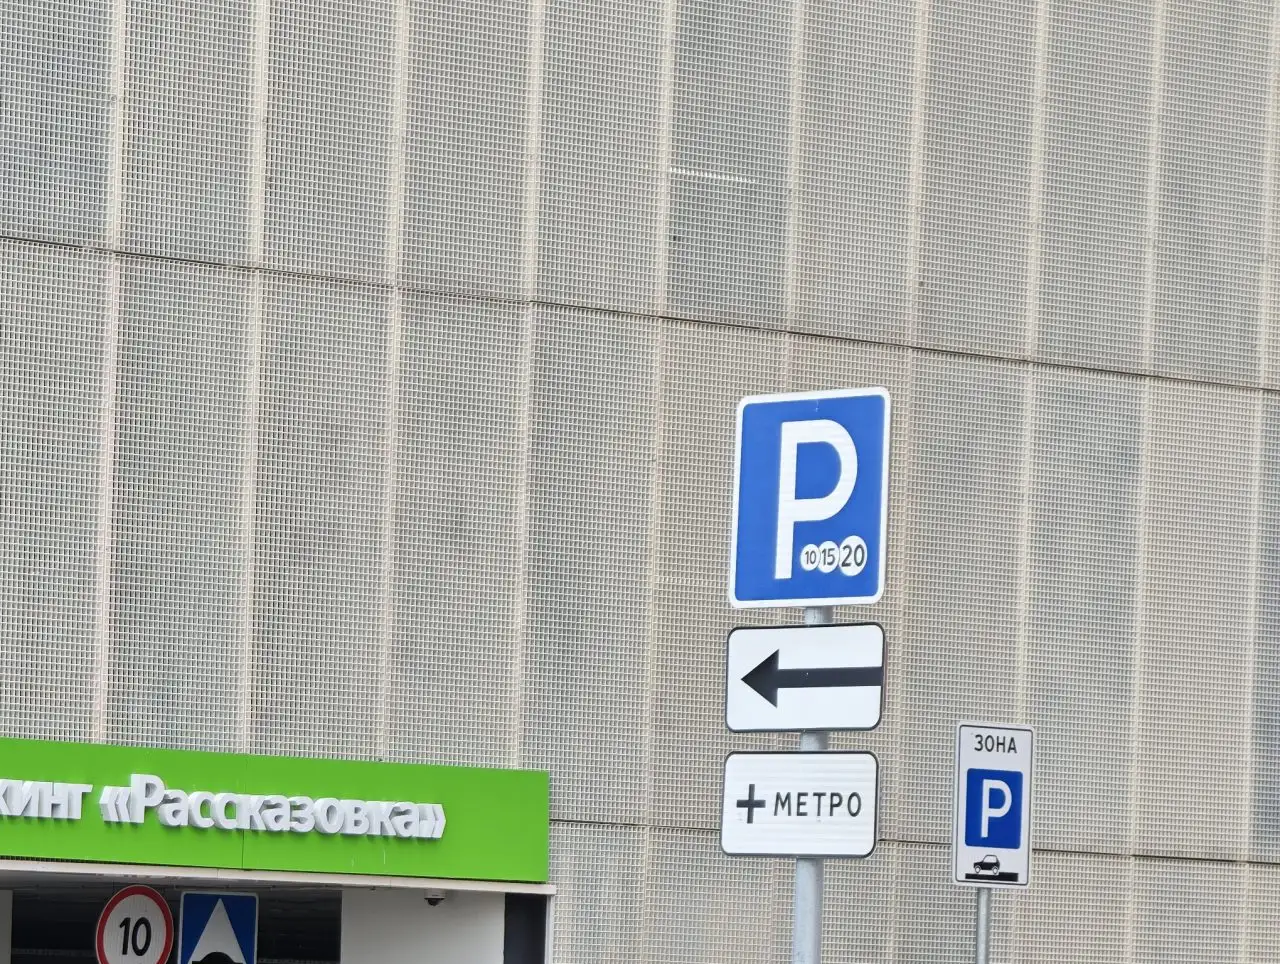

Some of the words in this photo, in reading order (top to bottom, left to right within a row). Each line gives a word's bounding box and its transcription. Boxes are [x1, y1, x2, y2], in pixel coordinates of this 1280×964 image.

[774, 418, 858, 580] P
[804, 550, 817, 565] 10
[821, 547, 836, 566] 15
[841, 543, 866, 568] 20
[974, 733, 1018, 755] ЗОНА
[99, 773, 447, 840] «Рассказовка»
[773, 791, 863, 818] МЕТРО
[980, 778, 1013, 839] P
[119, 916, 152, 957] 10
